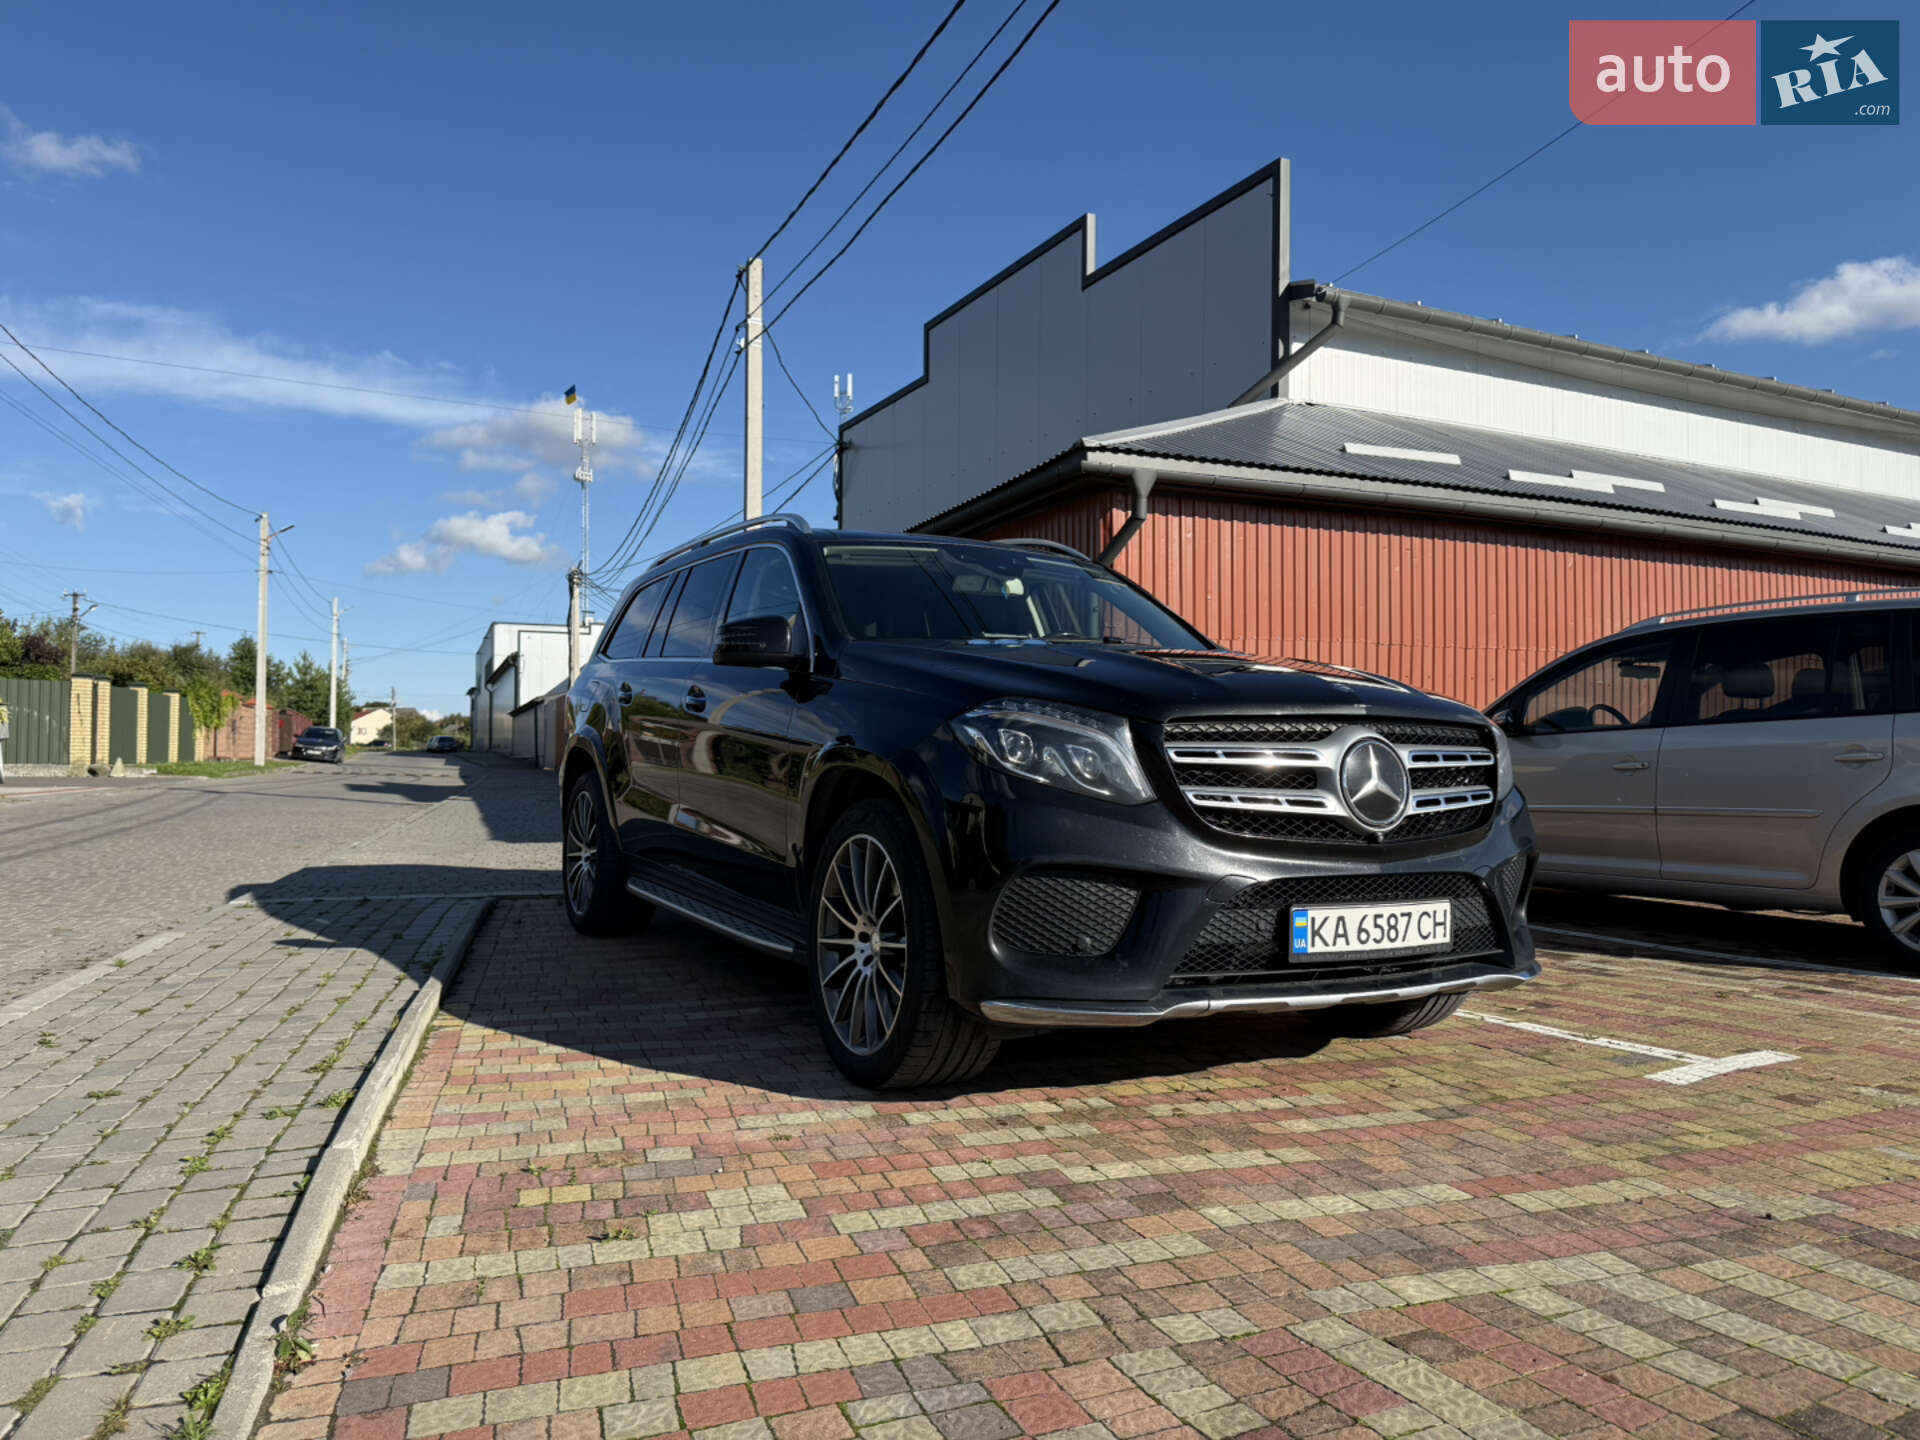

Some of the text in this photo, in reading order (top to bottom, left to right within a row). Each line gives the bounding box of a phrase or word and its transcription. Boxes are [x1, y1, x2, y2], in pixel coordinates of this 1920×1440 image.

[1310, 909, 1448, 948] KA 6587 CH
[1294, 938, 1307, 948] UA
